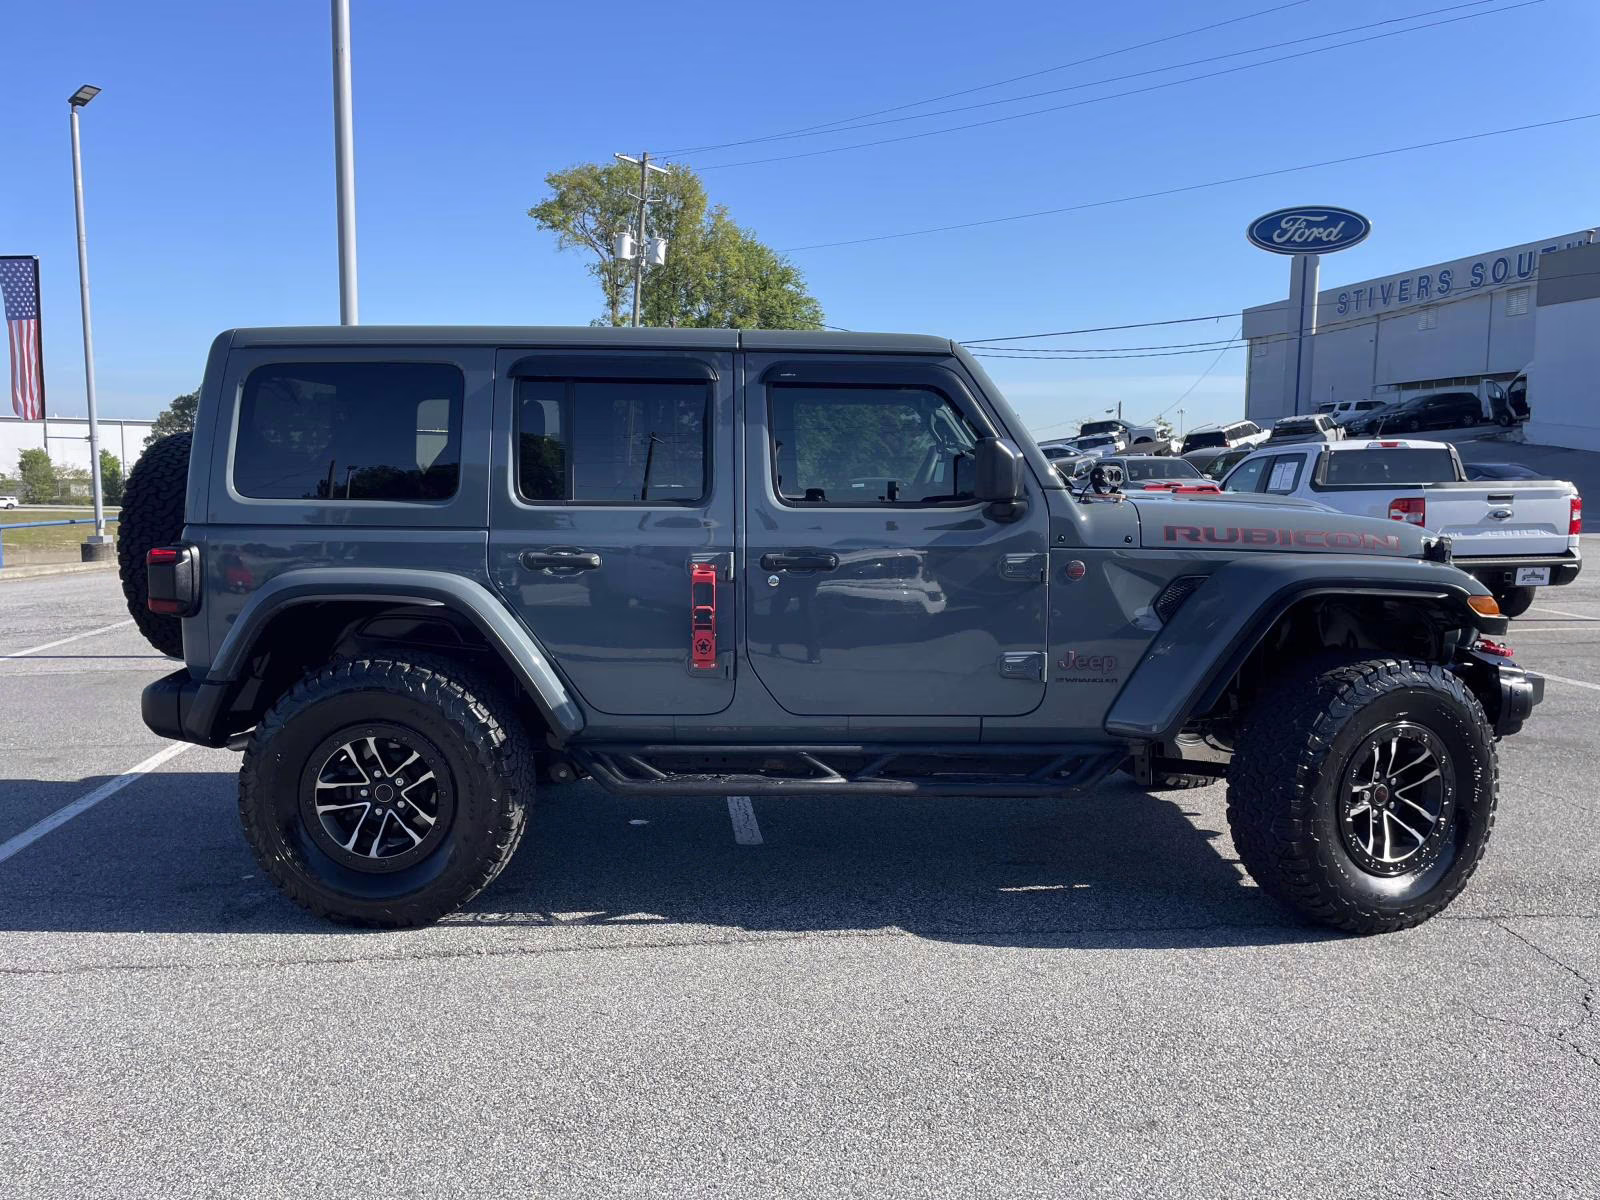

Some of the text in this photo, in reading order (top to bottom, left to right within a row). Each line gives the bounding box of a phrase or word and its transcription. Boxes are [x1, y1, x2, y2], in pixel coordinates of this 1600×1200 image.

[1272, 214, 1346, 244] Ford
[1336, 239, 1584, 316] STIVERS SOU
[1163, 525, 1400, 551] RUBICON
[1056, 649, 1117, 677] Jeep
